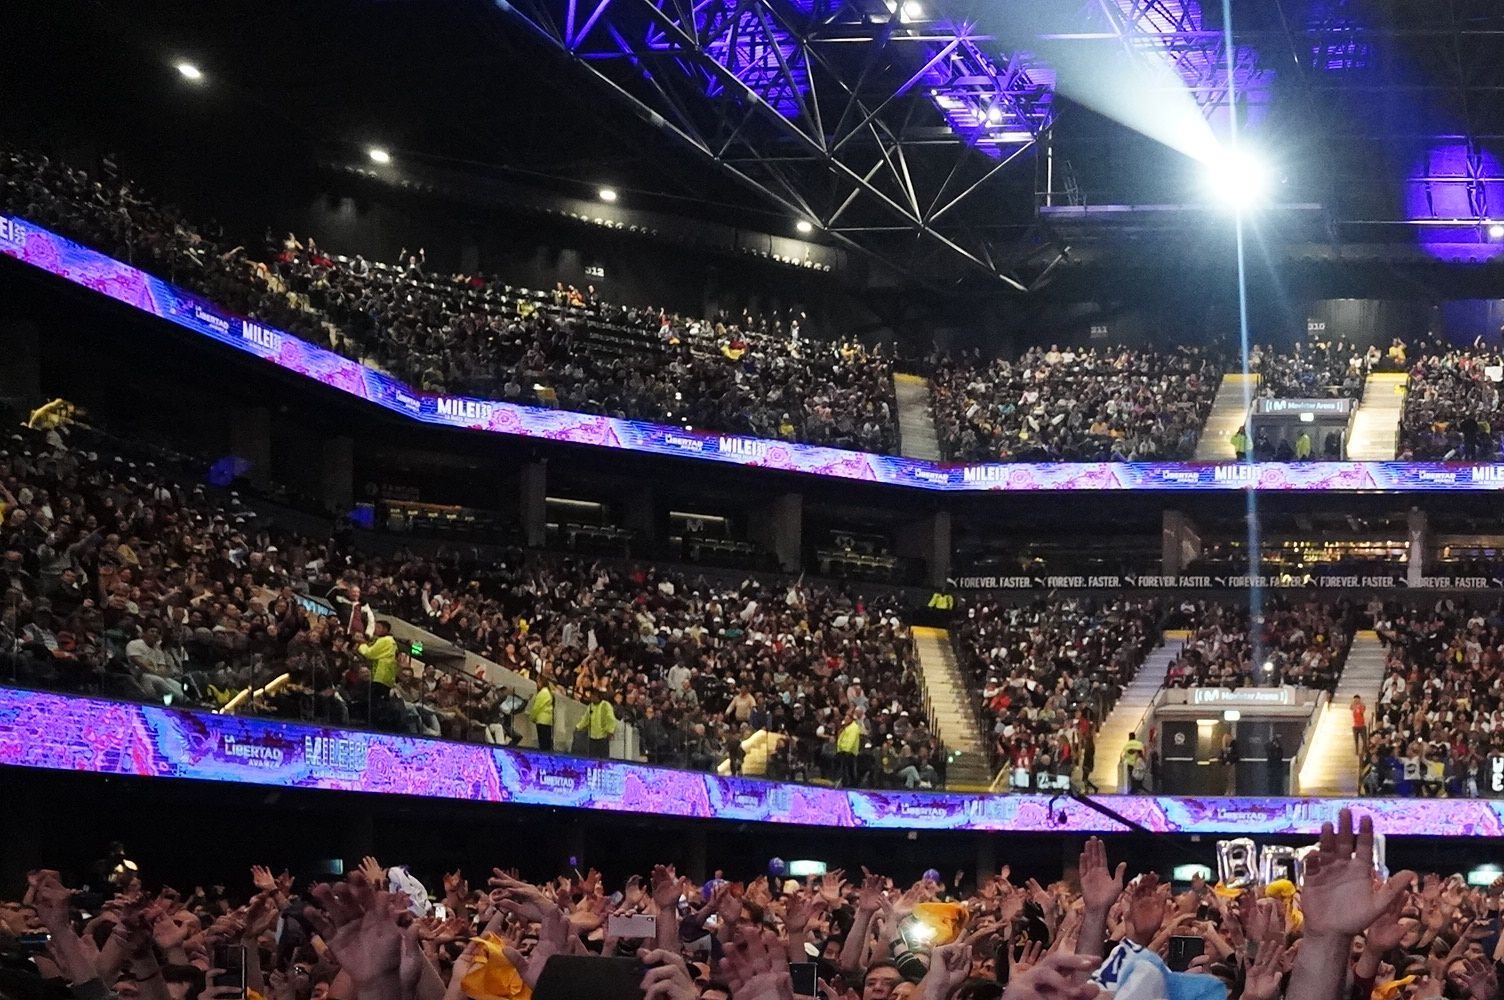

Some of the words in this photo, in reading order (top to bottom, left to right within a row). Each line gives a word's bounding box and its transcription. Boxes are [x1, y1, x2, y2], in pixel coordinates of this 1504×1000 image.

[243, 321, 274, 348] MILEI
[438, 398, 481, 418] MILEI
[1288, 402, 1314, 410] Movistar
[1316, 402, 1335, 410] Arena
[720, 437, 757, 456] MILEI
[964, 467, 1001, 481] MILEI
[1214, 466, 1251, 480] MILEI
[960, 577, 999, 587] FOREVER.
[1000, 577, 1032, 587] FASTER.
[1048, 576, 1087, 587] FOREVER.
[1088, 577, 1122, 587] FASTER.
[1138, 576, 1177, 587] FOREVER.
[1179, 577, 1213, 587] FASTER.
[1320, 576, 1360, 587] FOREVER.
[1362, 577, 1396, 588] FASTER.
[1455, 577, 1489, 588] FASTER.
[225, 743, 282, 760] LIBERTAD
[306, 735, 354, 769] MILEI
